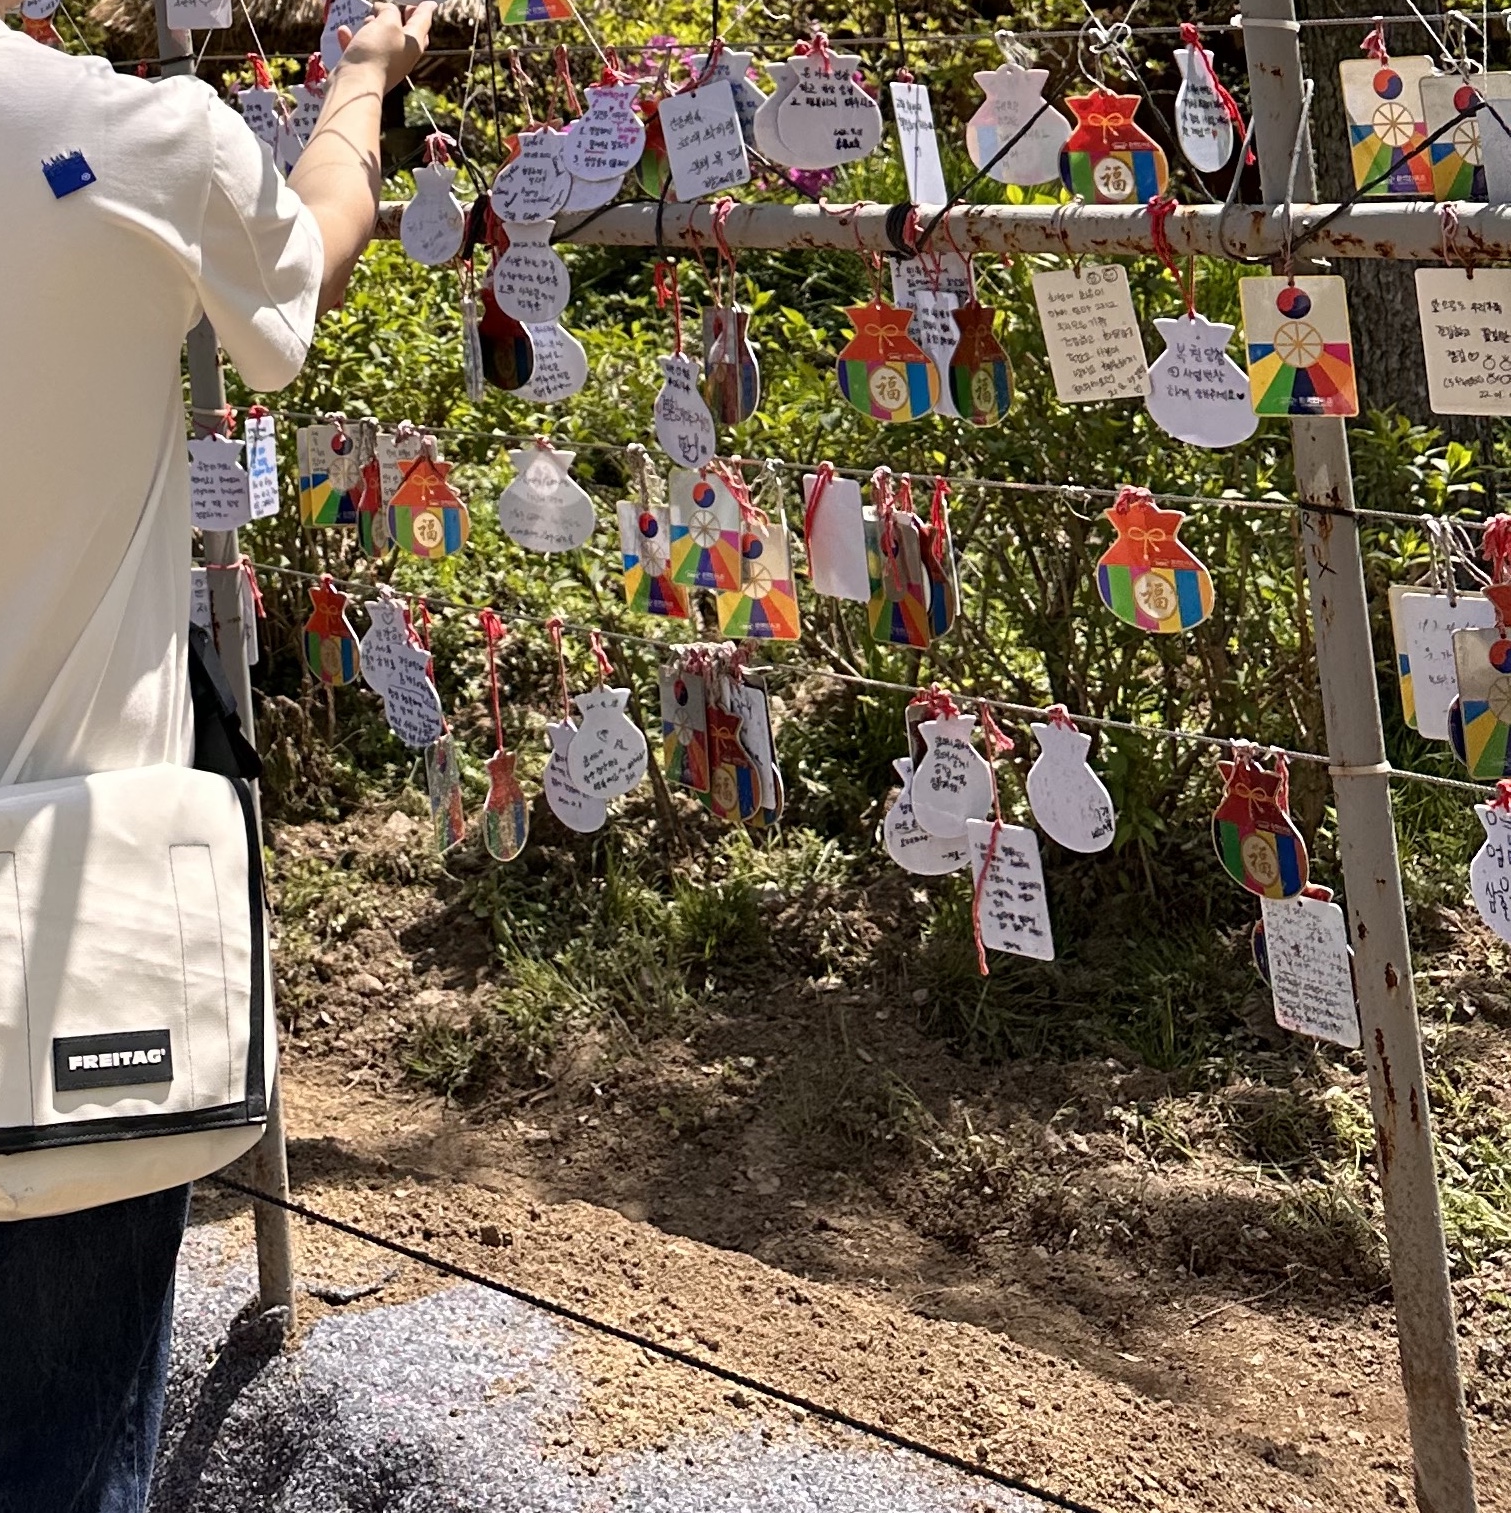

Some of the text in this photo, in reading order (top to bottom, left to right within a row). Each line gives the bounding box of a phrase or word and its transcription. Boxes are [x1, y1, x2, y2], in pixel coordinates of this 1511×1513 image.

[1099, 165, 1126, 192] 福
[875, 374, 901, 402] 福
[417, 518, 438, 542] 福
[1139, 581, 1169, 610] 福
[1246, 843, 1274, 879] 福
[68, 1049, 163, 1071] FREITAG
